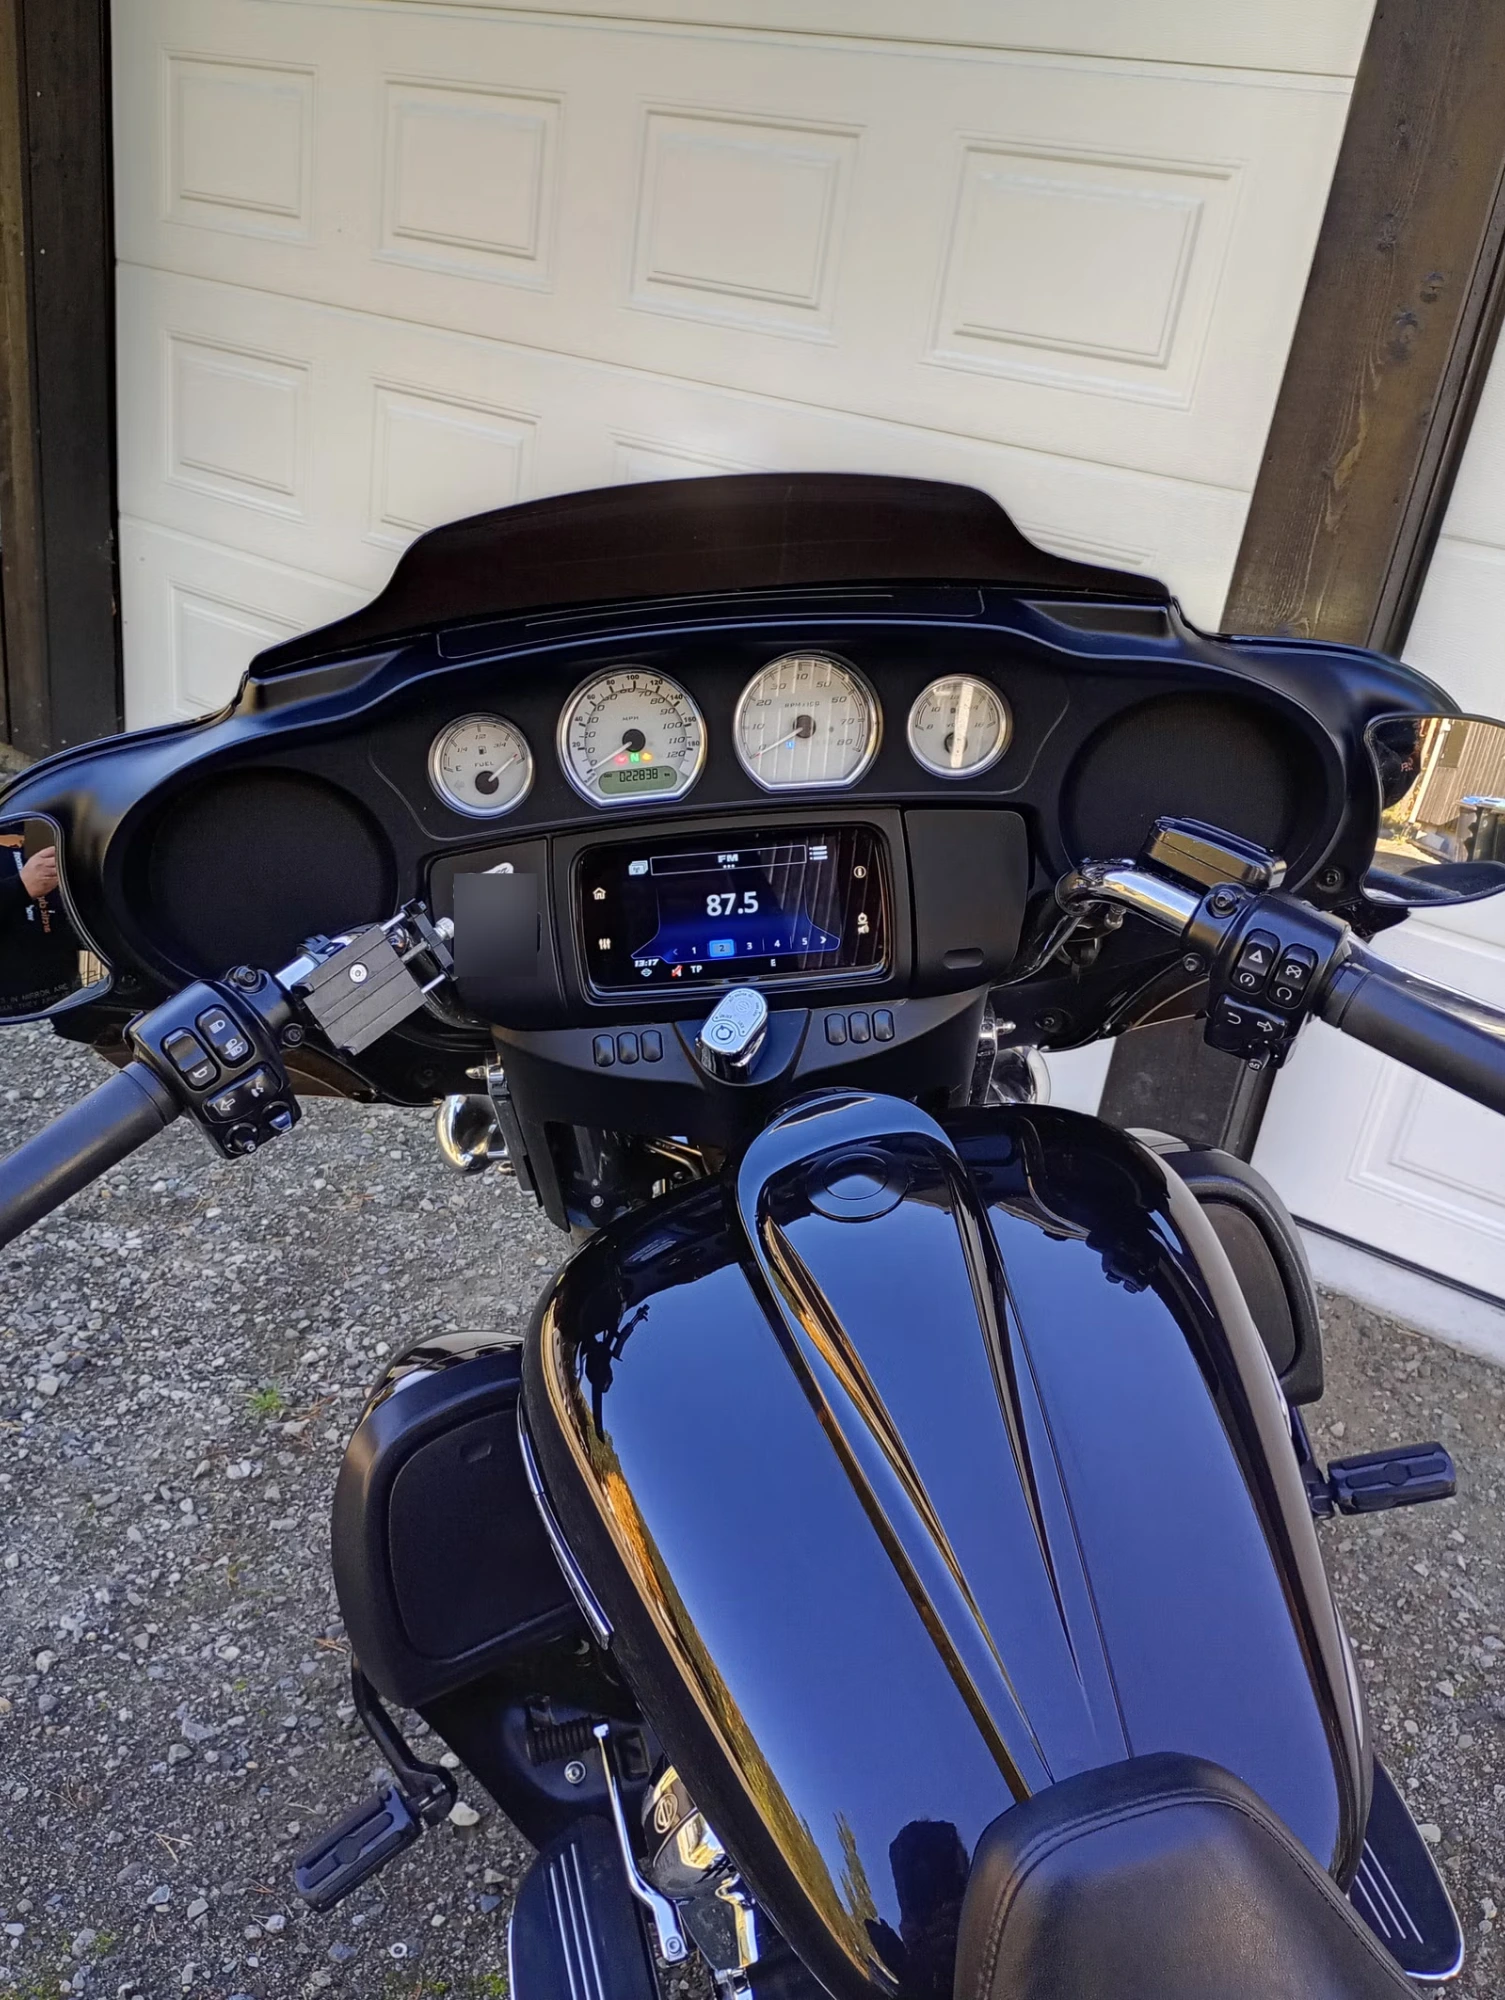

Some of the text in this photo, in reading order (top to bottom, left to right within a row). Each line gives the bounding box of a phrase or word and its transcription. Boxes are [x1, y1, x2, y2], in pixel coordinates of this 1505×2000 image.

[663, 721, 683, 729] 100
[668, 736, 686, 744] 110
[667, 750, 686, 758] 120
[619, 768, 659, 782] 022838
[718, 854, 739, 863] FM
[706, 891, 759, 917] 87.5
[746, 942, 753, 950] 3
[690, 959, 776, 973] TP E
